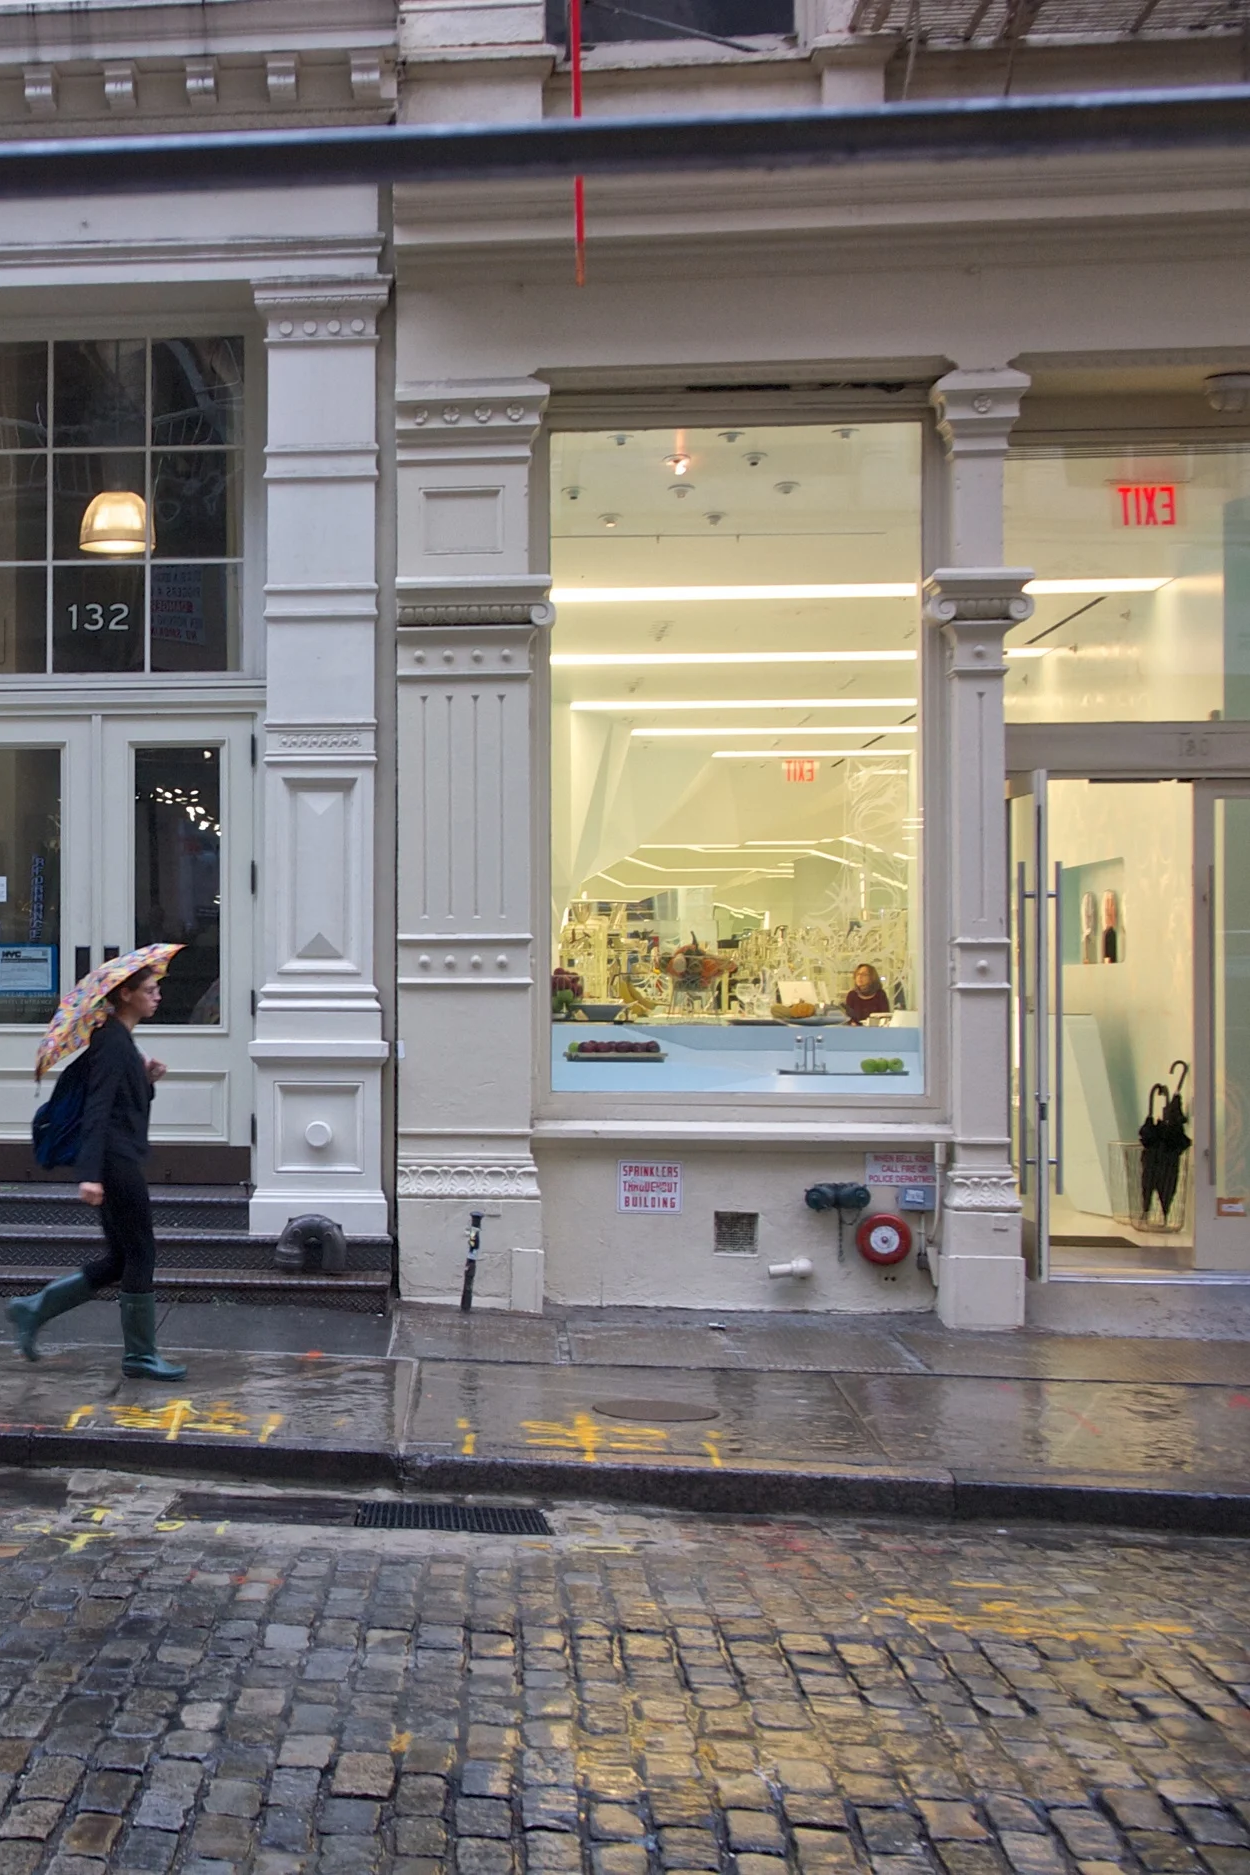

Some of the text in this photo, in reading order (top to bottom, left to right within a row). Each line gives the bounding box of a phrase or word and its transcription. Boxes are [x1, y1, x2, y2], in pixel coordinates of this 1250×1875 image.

[68, 603, 129, 631] 132
[2, 951, 22, 959] NYC
[622, 1165, 679, 1178] SPRINKLERS
[881, 1165, 928, 1173] CALL FIRE OR
[869, 1175, 936, 1183] POLICE DEPARTMEN
[622, 1181, 678, 1193] THROUGHOUT
[624, 1196, 676, 1209] BUILDING
